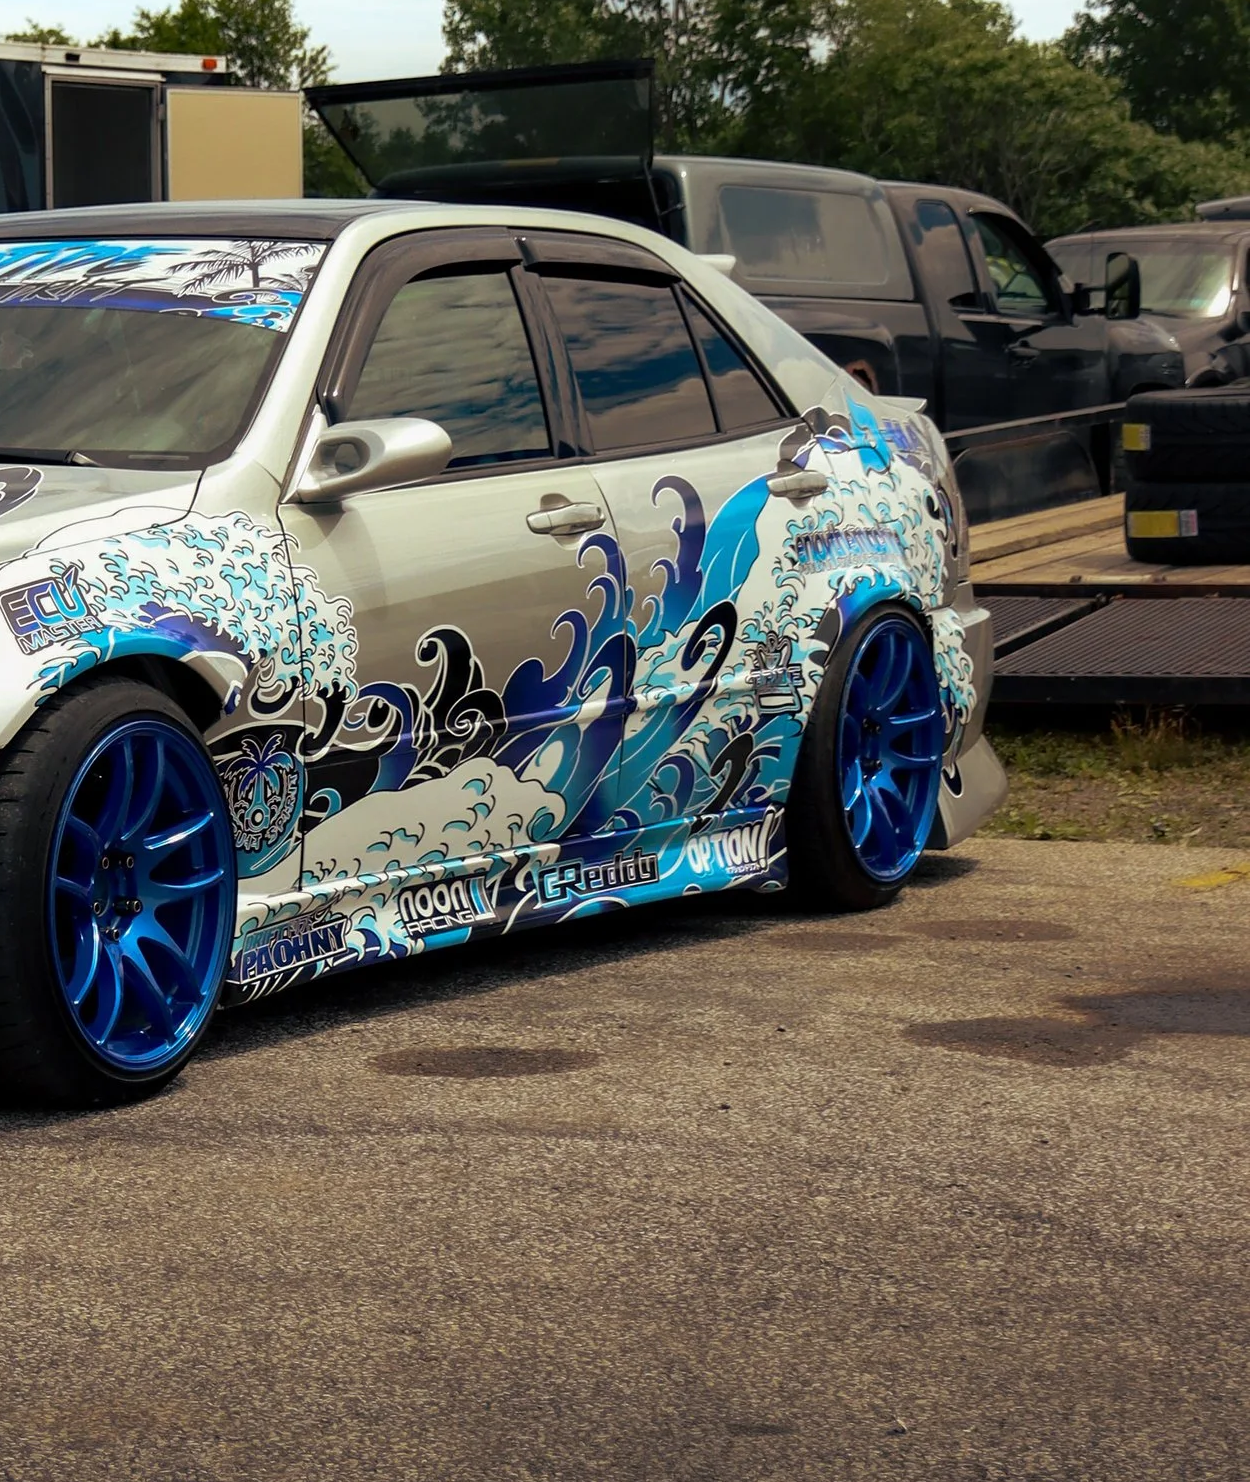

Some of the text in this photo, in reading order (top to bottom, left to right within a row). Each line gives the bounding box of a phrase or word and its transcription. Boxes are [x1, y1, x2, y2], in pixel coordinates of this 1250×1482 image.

[0, 566, 88, 637] ECU
[17, 615, 104, 654] MASTER
[687, 809, 770, 873] OPTION!
[538, 846, 660, 905] GReddy
[241, 920, 348, 982] PAOHNY
[406, 911, 475, 936] RACING
